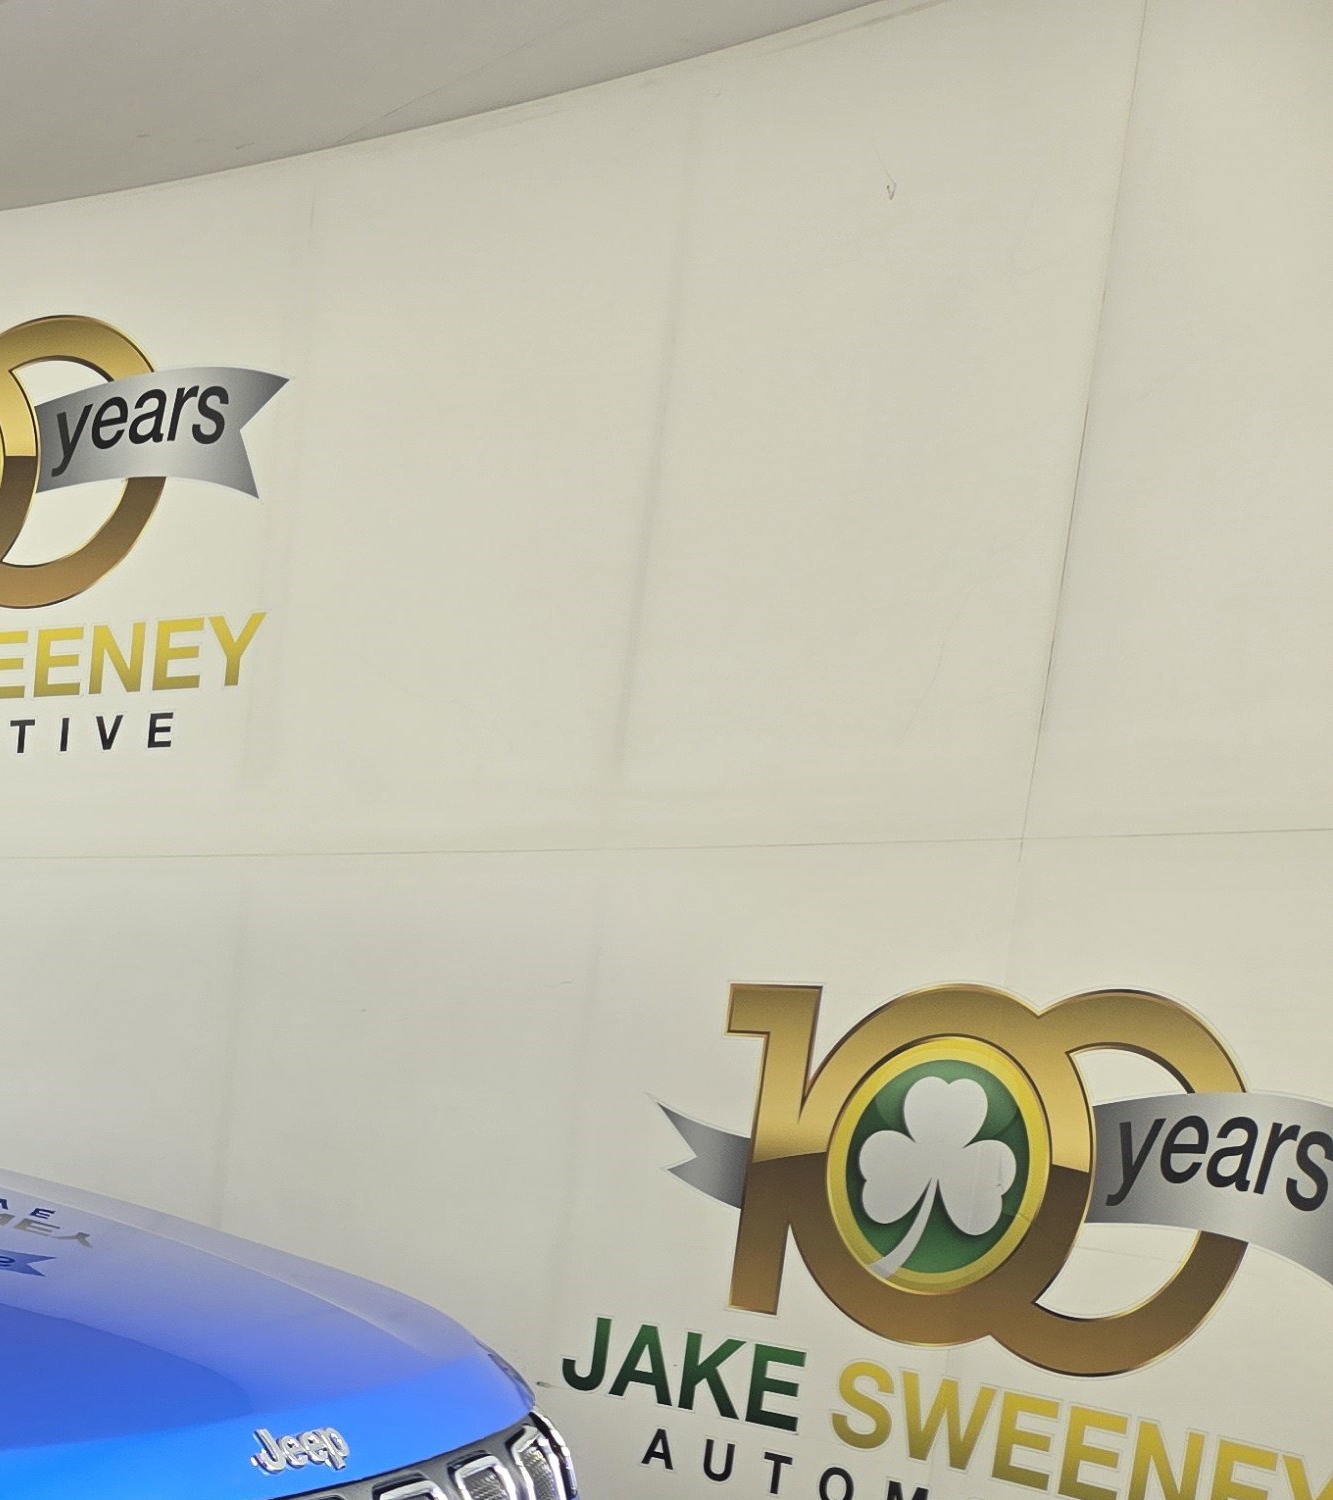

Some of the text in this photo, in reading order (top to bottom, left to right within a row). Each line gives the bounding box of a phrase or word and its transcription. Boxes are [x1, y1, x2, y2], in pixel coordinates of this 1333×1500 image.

[50, 383, 231, 478] years
[727, 983, 1248, 1377] 100
[1106, 1114, 1333, 1212] years
[561, 1316, 808, 1433] JAKE
[250, 1426, 351, 1476] Jeep
